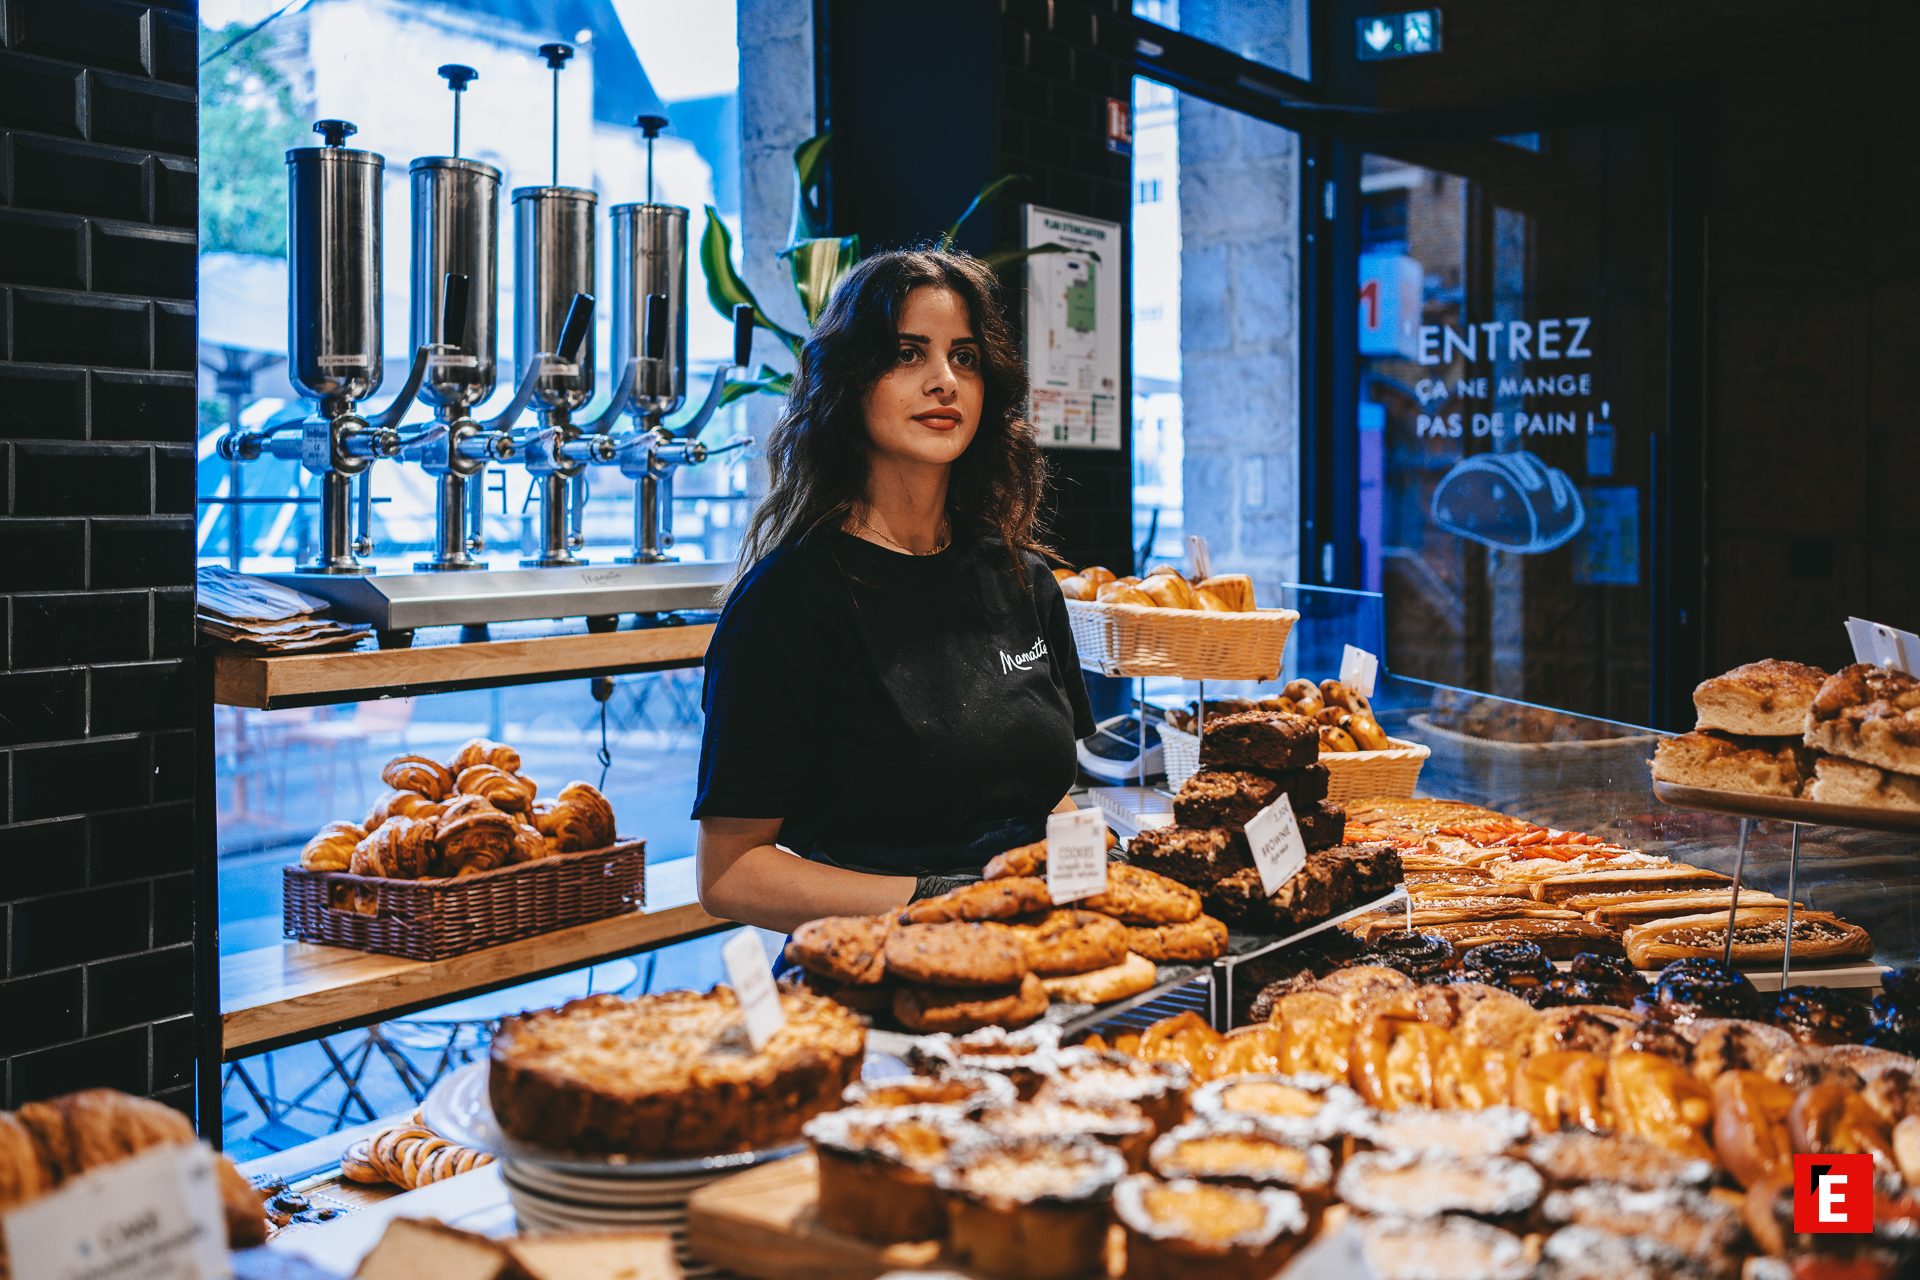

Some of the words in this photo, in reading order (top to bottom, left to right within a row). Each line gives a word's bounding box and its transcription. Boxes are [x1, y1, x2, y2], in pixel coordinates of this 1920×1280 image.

[1415, 377, 1448, 405] ÇA
[1456, 377, 1489, 399] NE
[1498, 373, 1592, 399] MANGE
[1416, 413, 1464, 438] PAS
[1472, 412, 1504, 437] DE
[1514, 410, 1576, 436] PAIN
[1000, 636, 1048, 675] Mamatte
